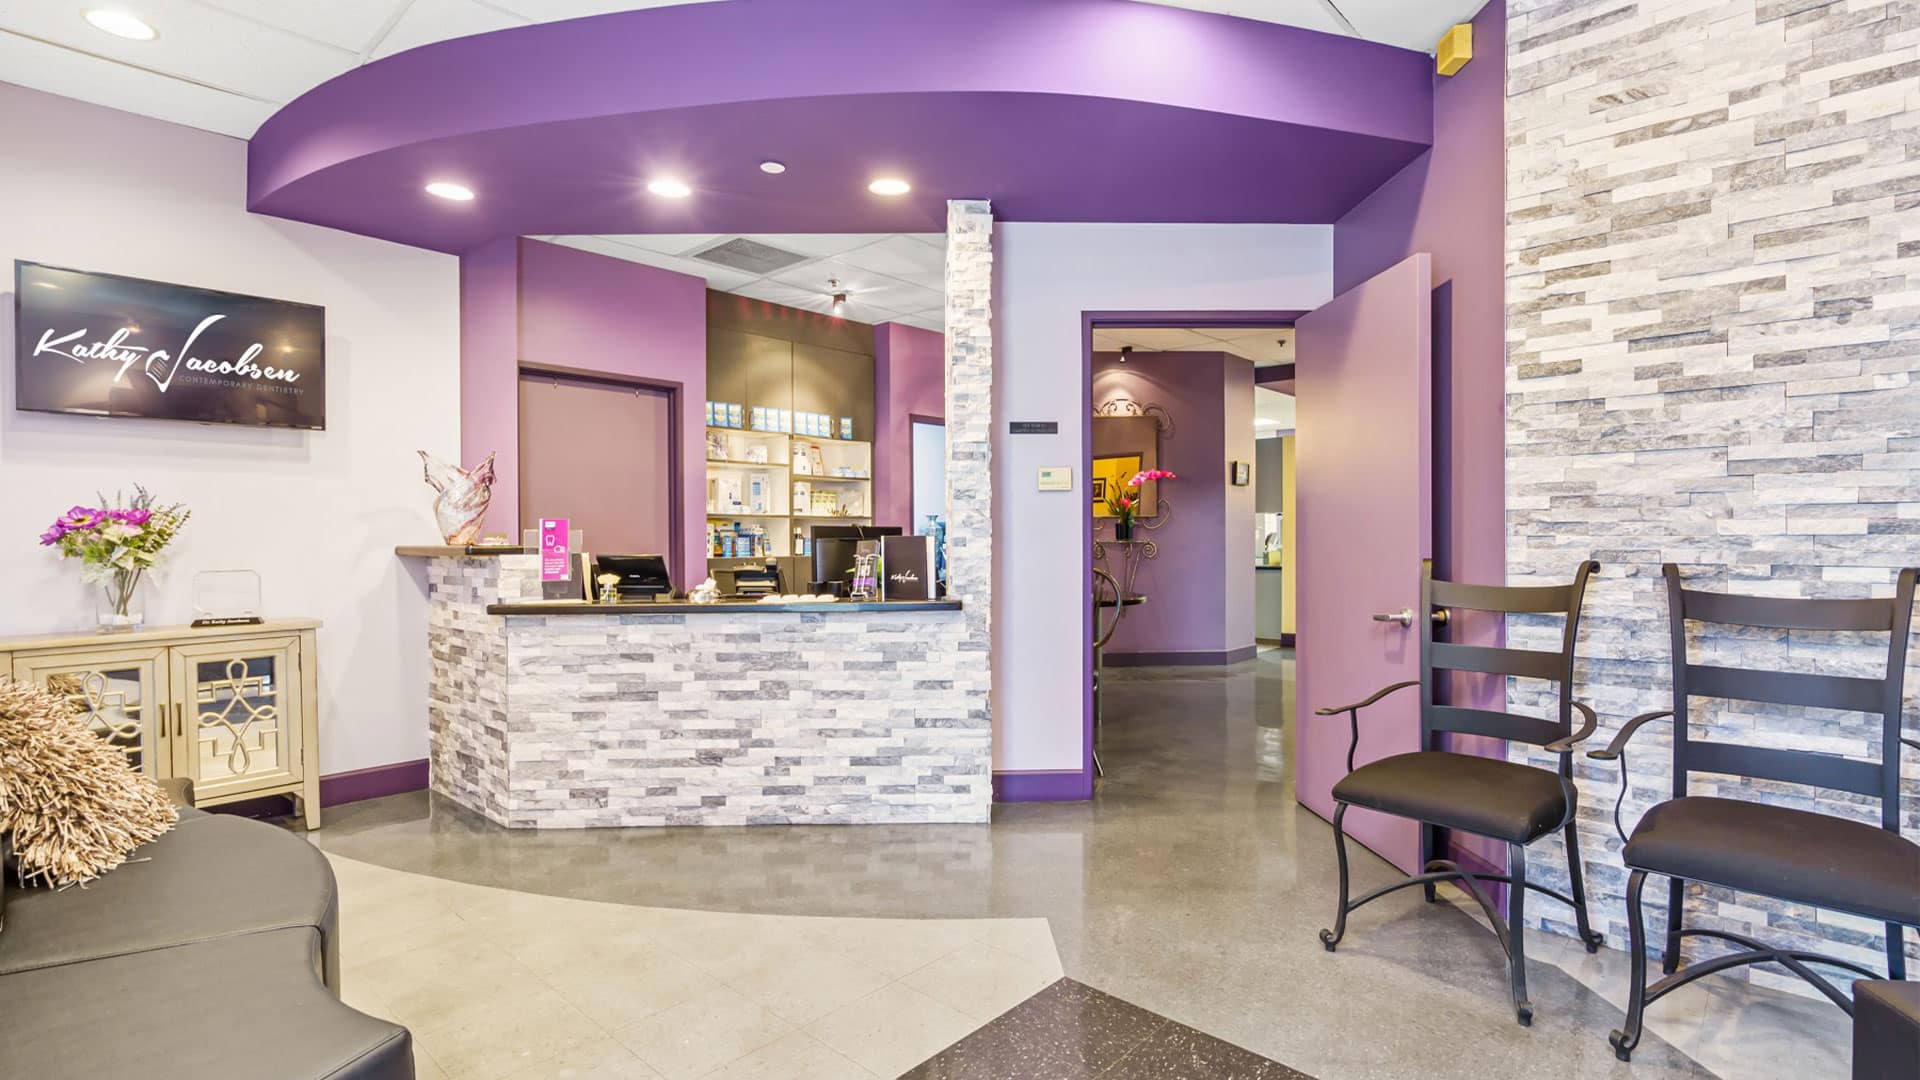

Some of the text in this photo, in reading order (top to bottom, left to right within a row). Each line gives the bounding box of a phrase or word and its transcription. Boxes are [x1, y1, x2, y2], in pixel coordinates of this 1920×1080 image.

[33, 315, 300, 393] Kathy Jacobsen
[179, 375, 304, 395] CONTEMPORARY DENTISTRY
